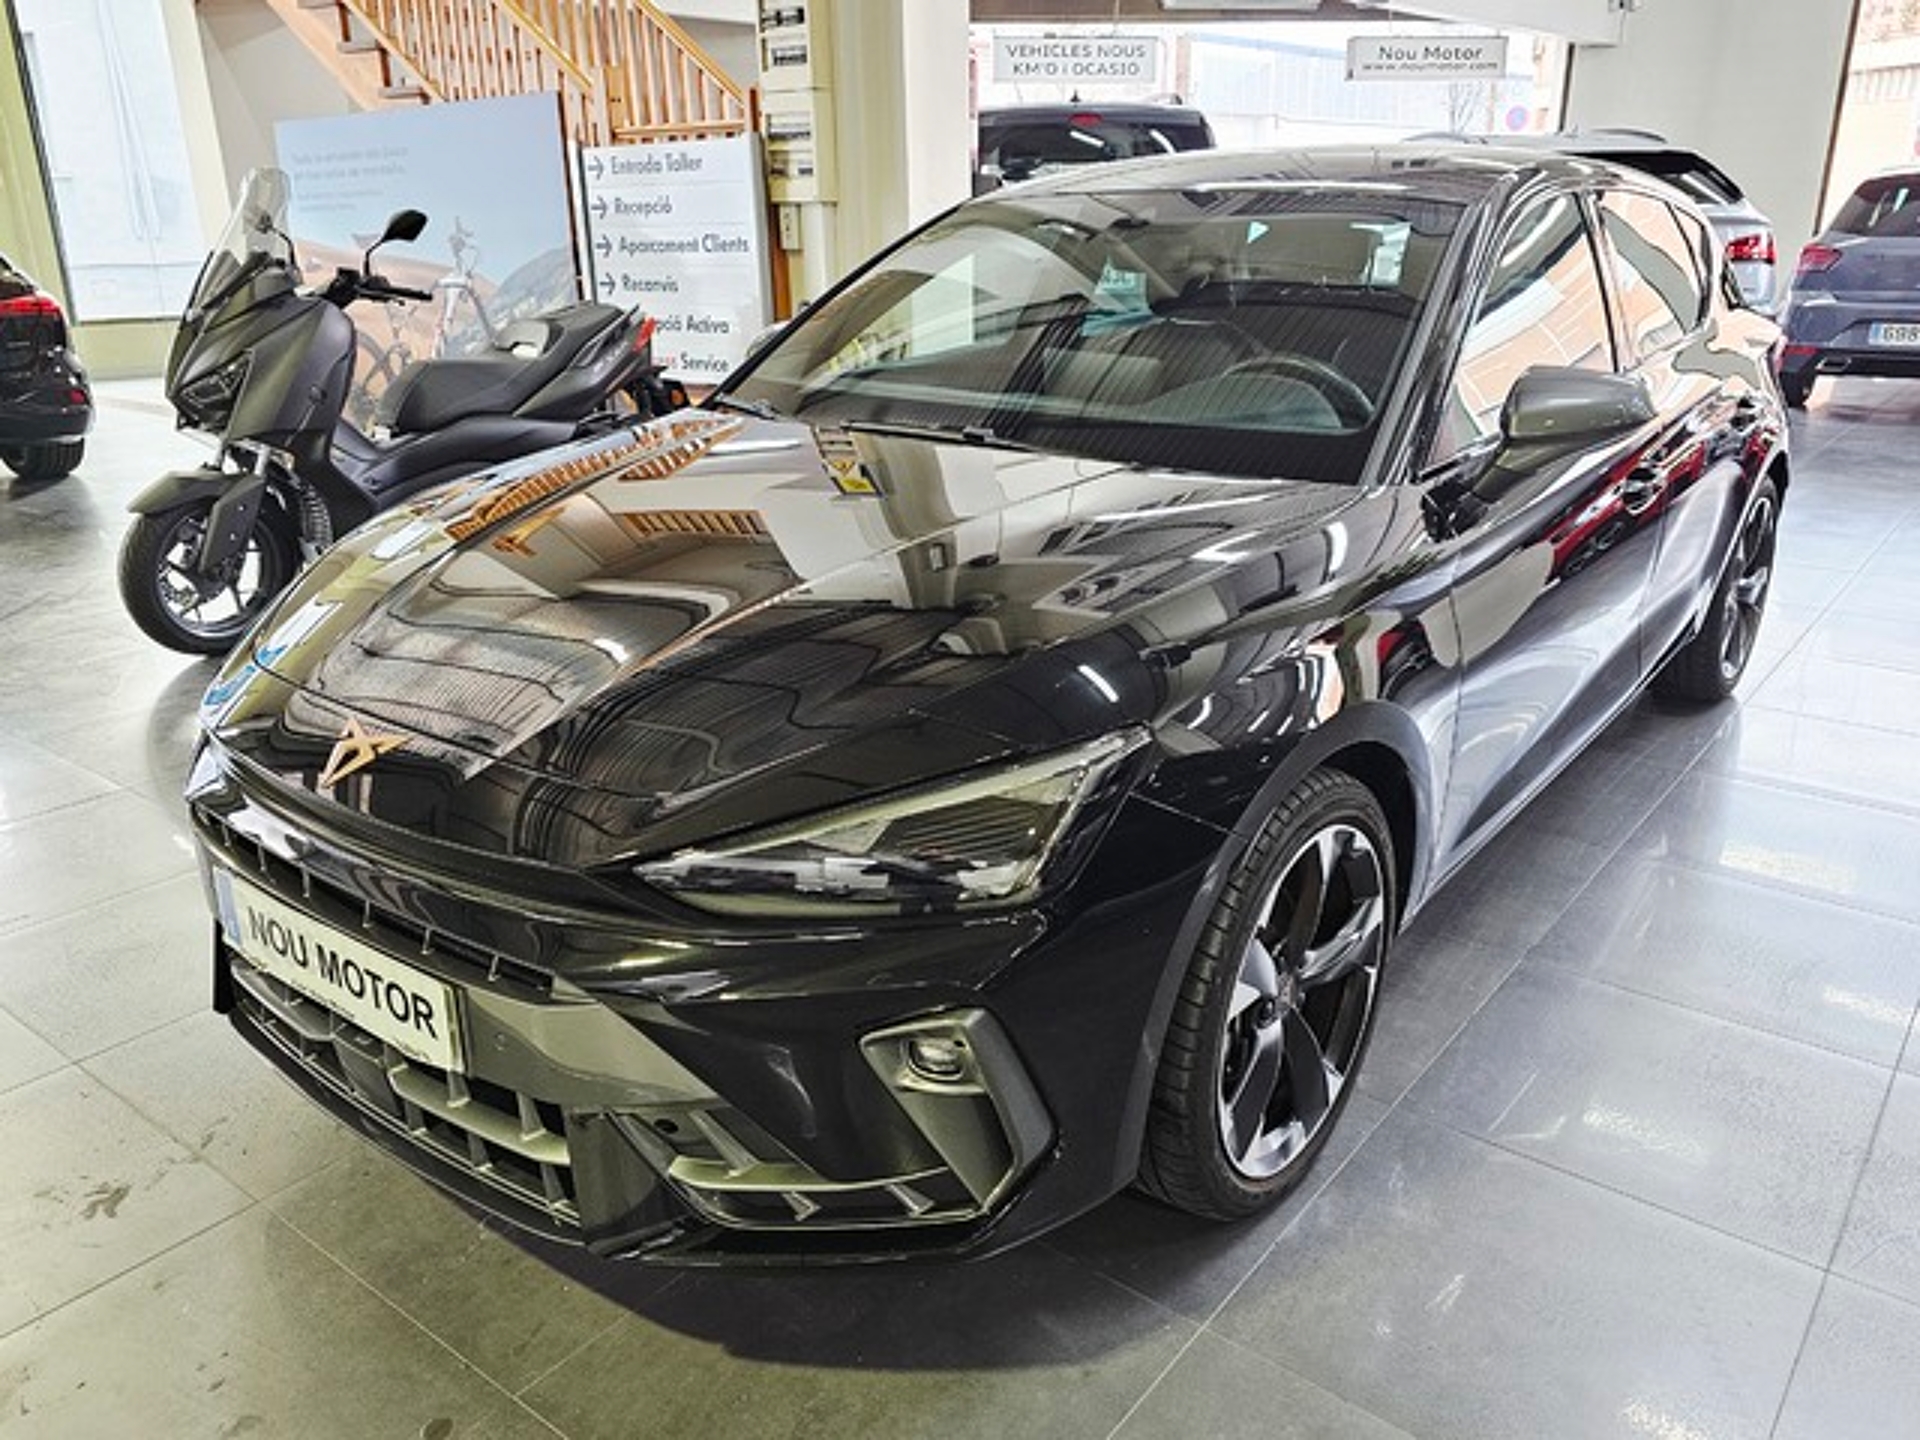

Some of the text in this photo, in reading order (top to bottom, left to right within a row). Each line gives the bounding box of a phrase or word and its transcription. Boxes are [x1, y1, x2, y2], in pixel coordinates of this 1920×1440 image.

[1006, 44, 1146, 58] VEHICLES NOUS
[1379, 46, 1484, 61] Nou Motor
[611, 152, 703, 175] Entrada Taller
[618, 233, 749, 257] Aparcament Clients
[686, 314, 730, 334] Activa
[681, 351, 729, 373] Service
[248, 906, 308, 969] NOU
[315, 942, 438, 1039] MOTOR
